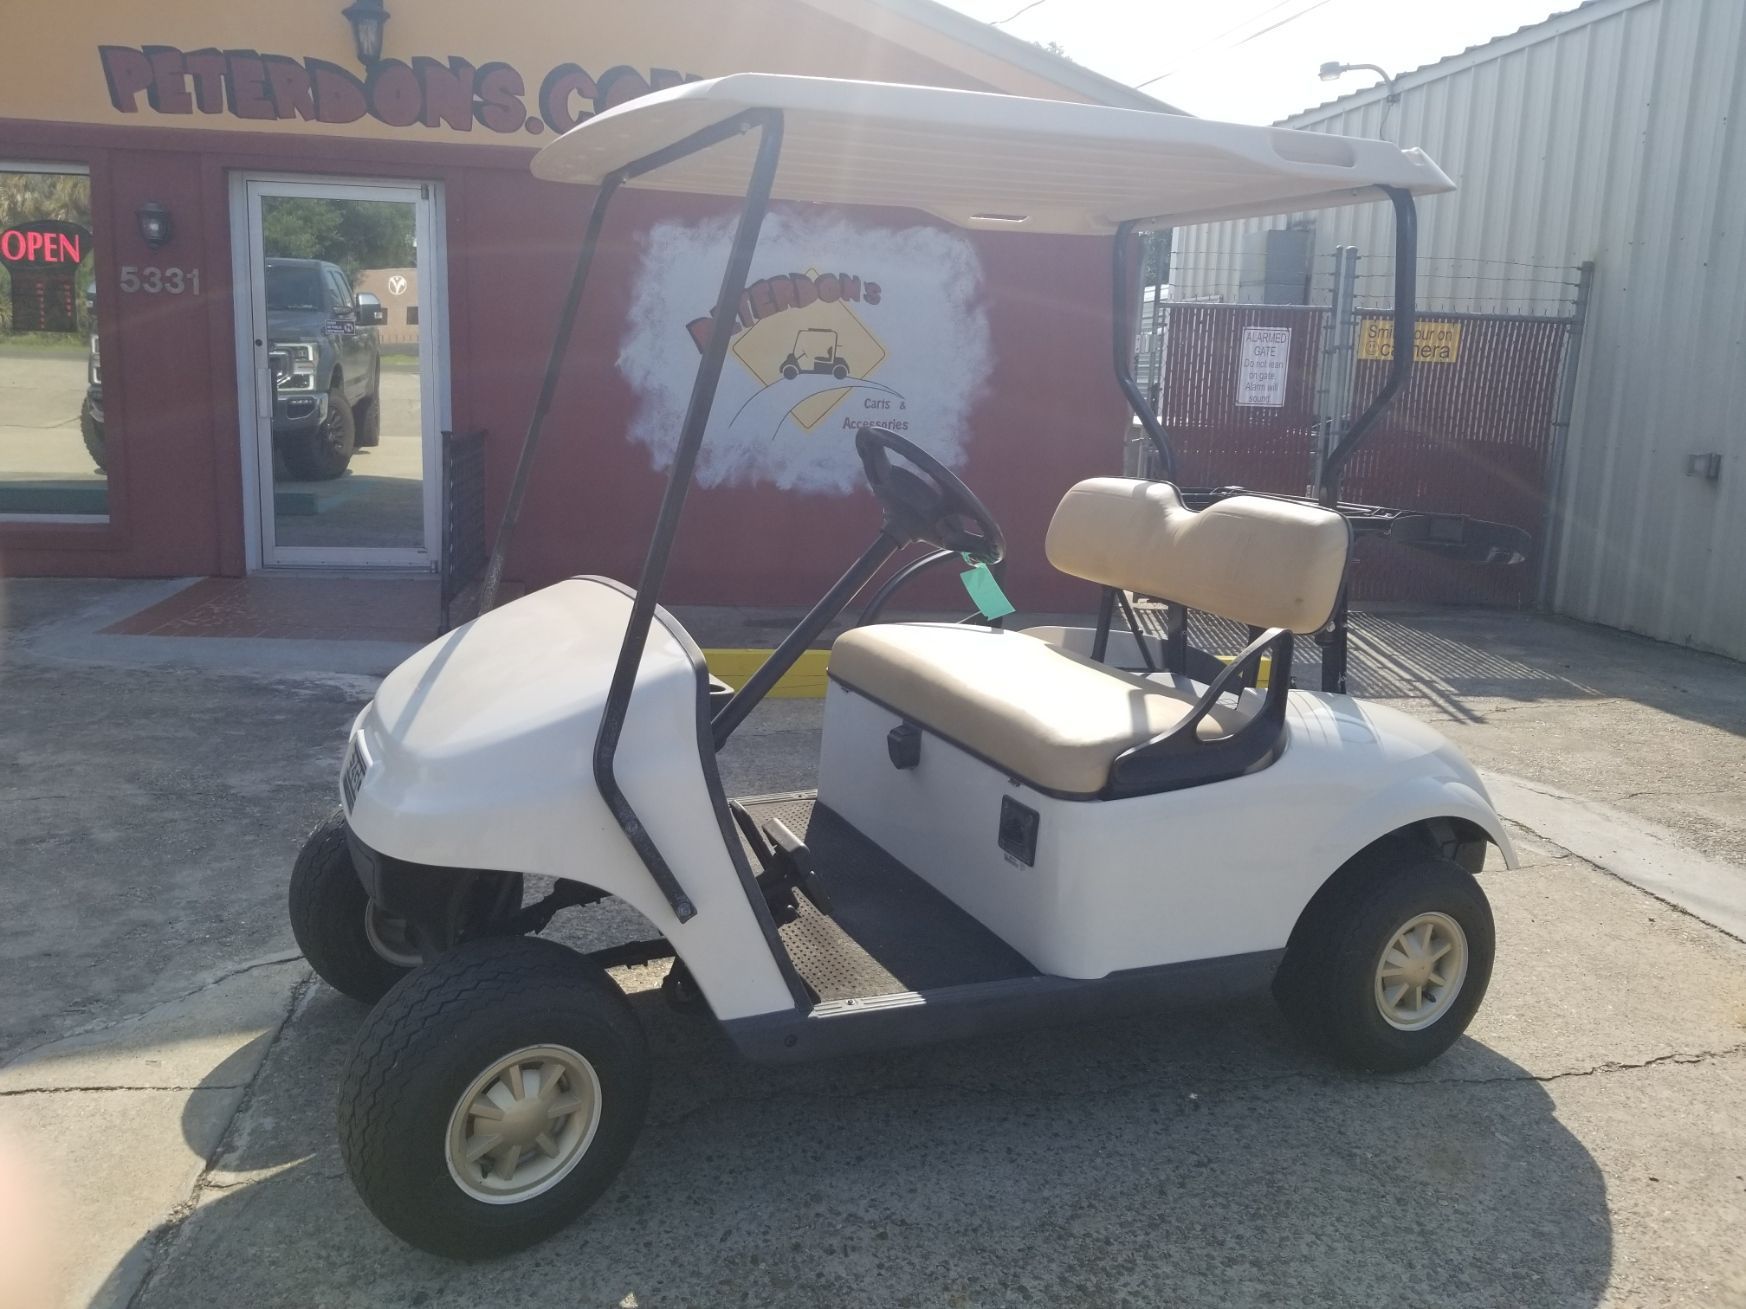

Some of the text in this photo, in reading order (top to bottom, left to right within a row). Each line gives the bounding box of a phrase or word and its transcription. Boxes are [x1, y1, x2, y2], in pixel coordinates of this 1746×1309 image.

[98, 45, 704, 135] PETERDONS.CO
[1, 230, 80, 263] OPEN
[120, 266, 200, 295] 5331
[1246, 331, 1287, 344] ALARMED
[1369, 325, 1452, 341] Smi our on
[1254, 346, 1276, 357] GATE
[1244, 358, 1284, 368] Do not lean
[1245, 382, 1278, 392] Alarm will
[864, 398, 891, 409] Carts
[842, 417, 909, 430] Accessories
